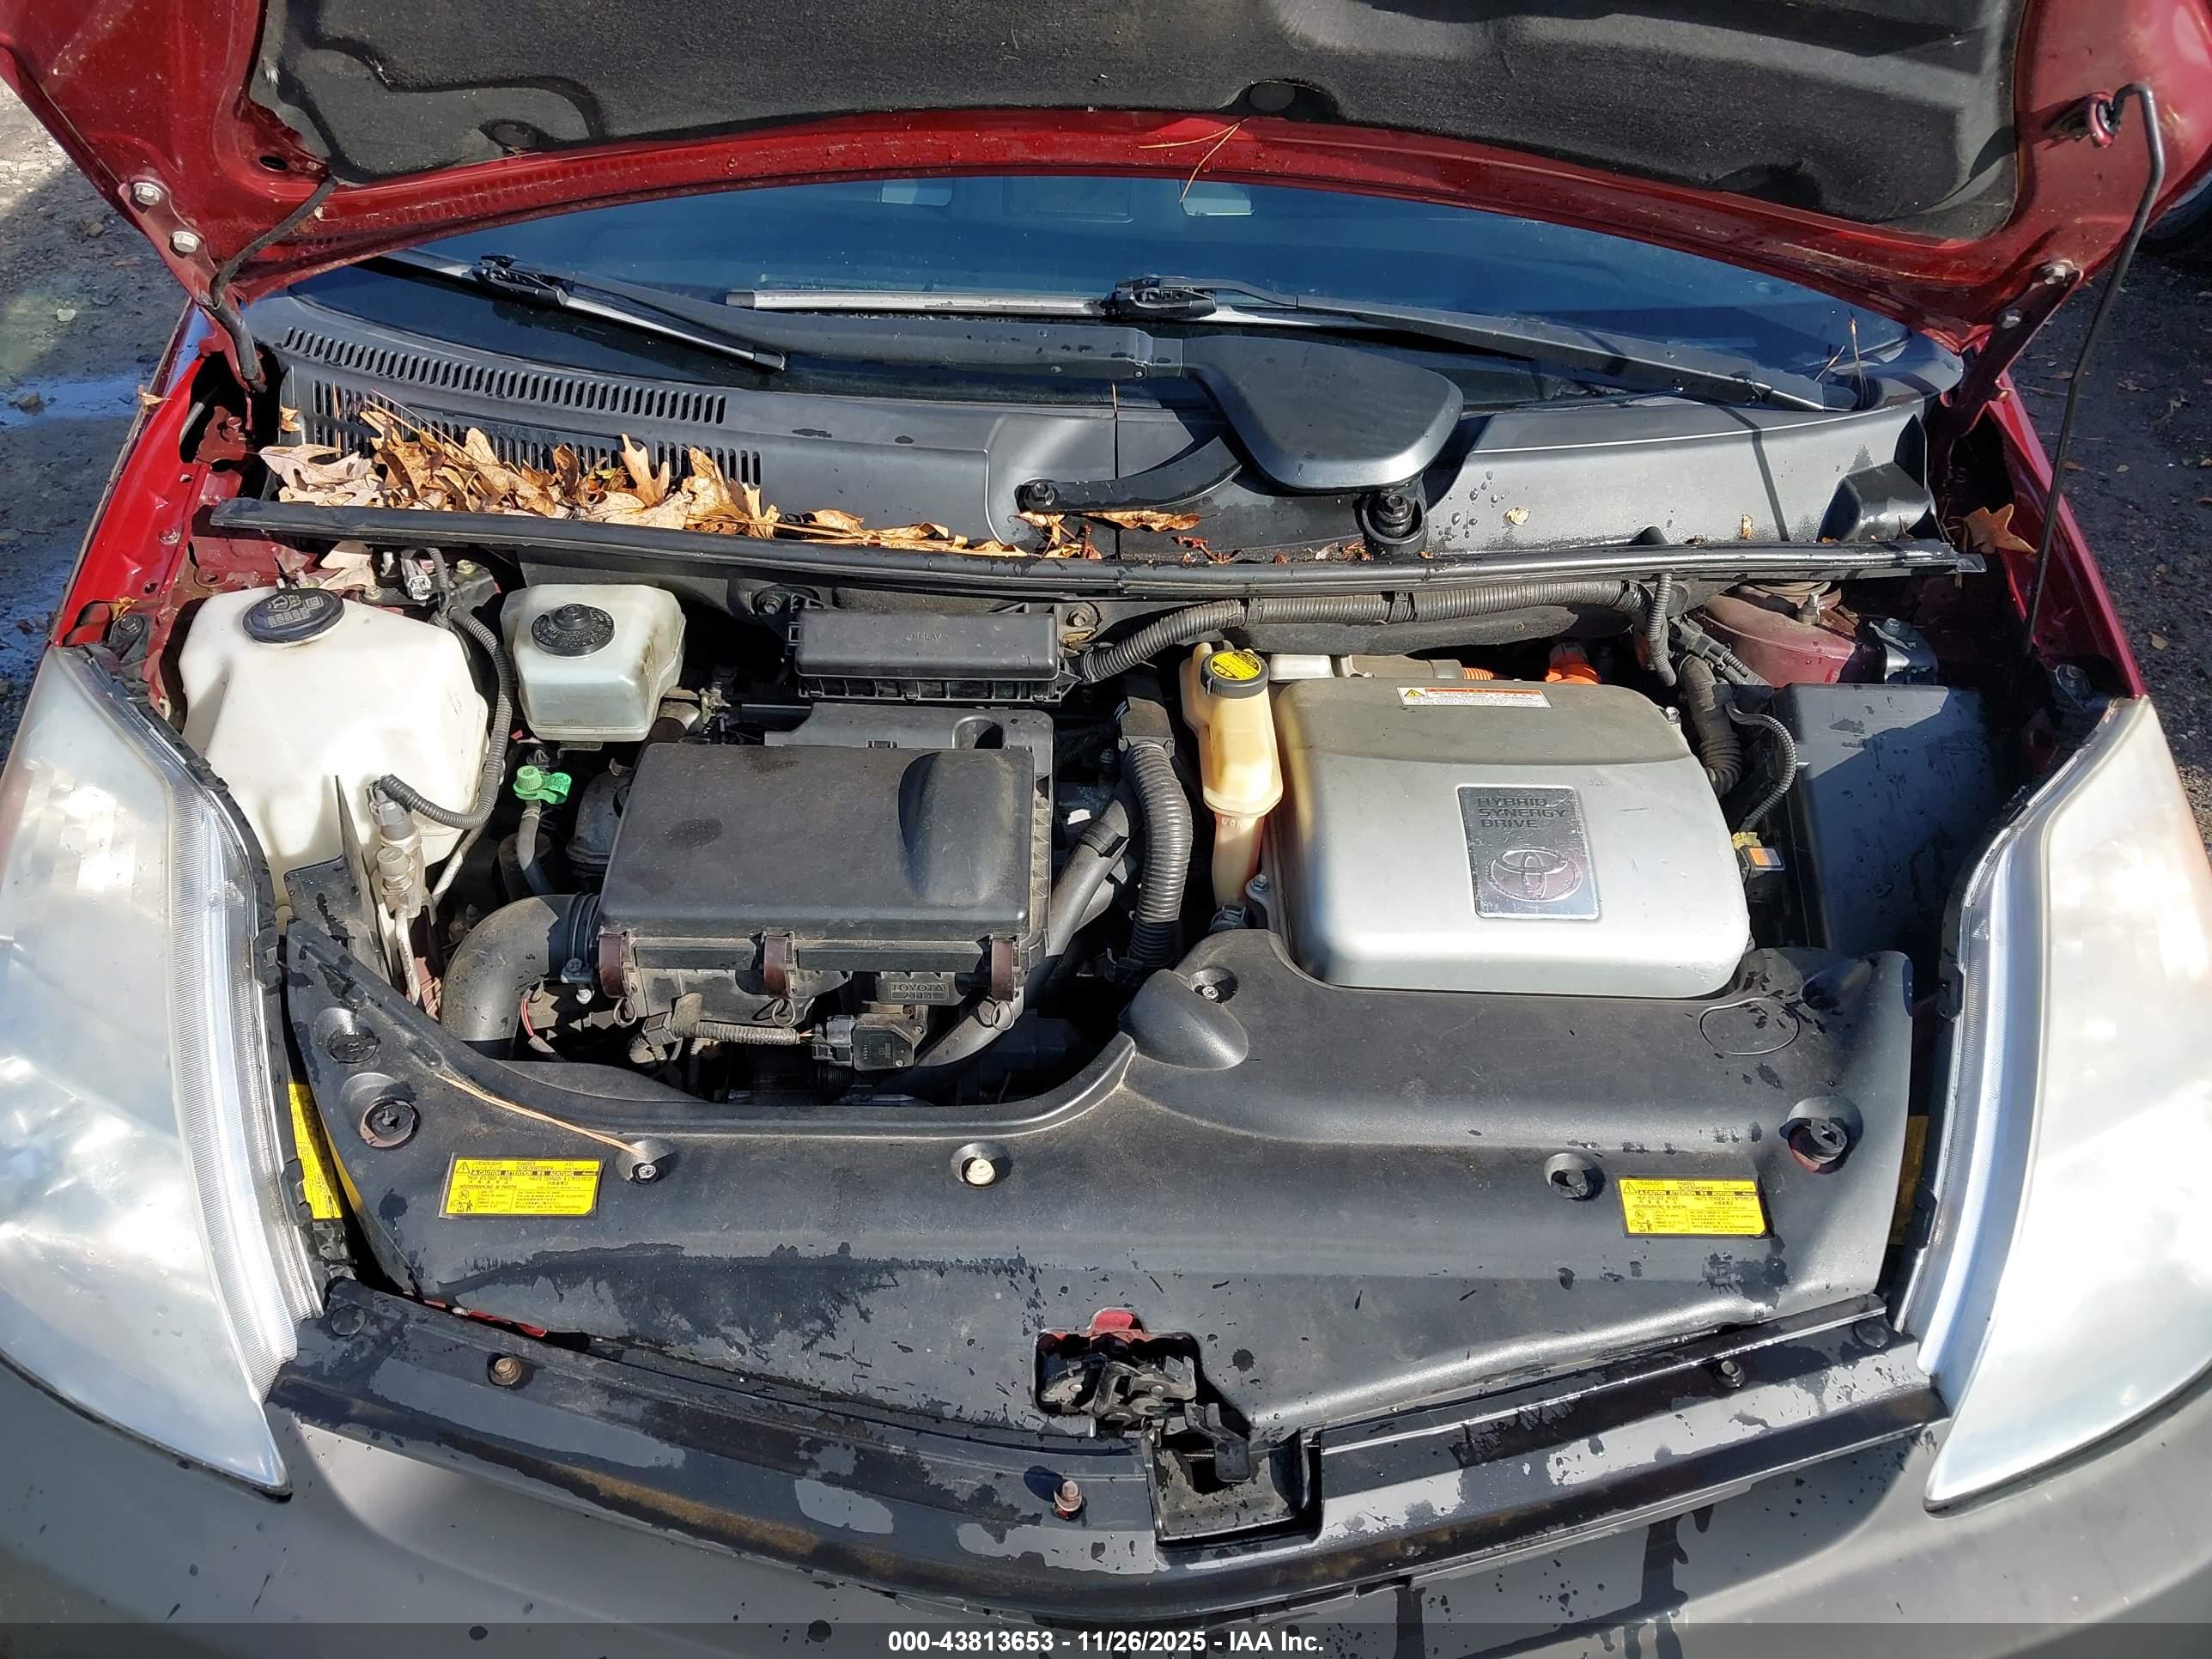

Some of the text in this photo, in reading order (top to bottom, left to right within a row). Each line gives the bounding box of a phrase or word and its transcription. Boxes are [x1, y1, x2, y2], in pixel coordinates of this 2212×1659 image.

[911, 632, 942, 641] RELAY
[1476, 798, 1547, 806] HYBRID
[1479, 808, 1567, 817] SYNERGY
[1480, 819, 1538, 828] DRIVE
